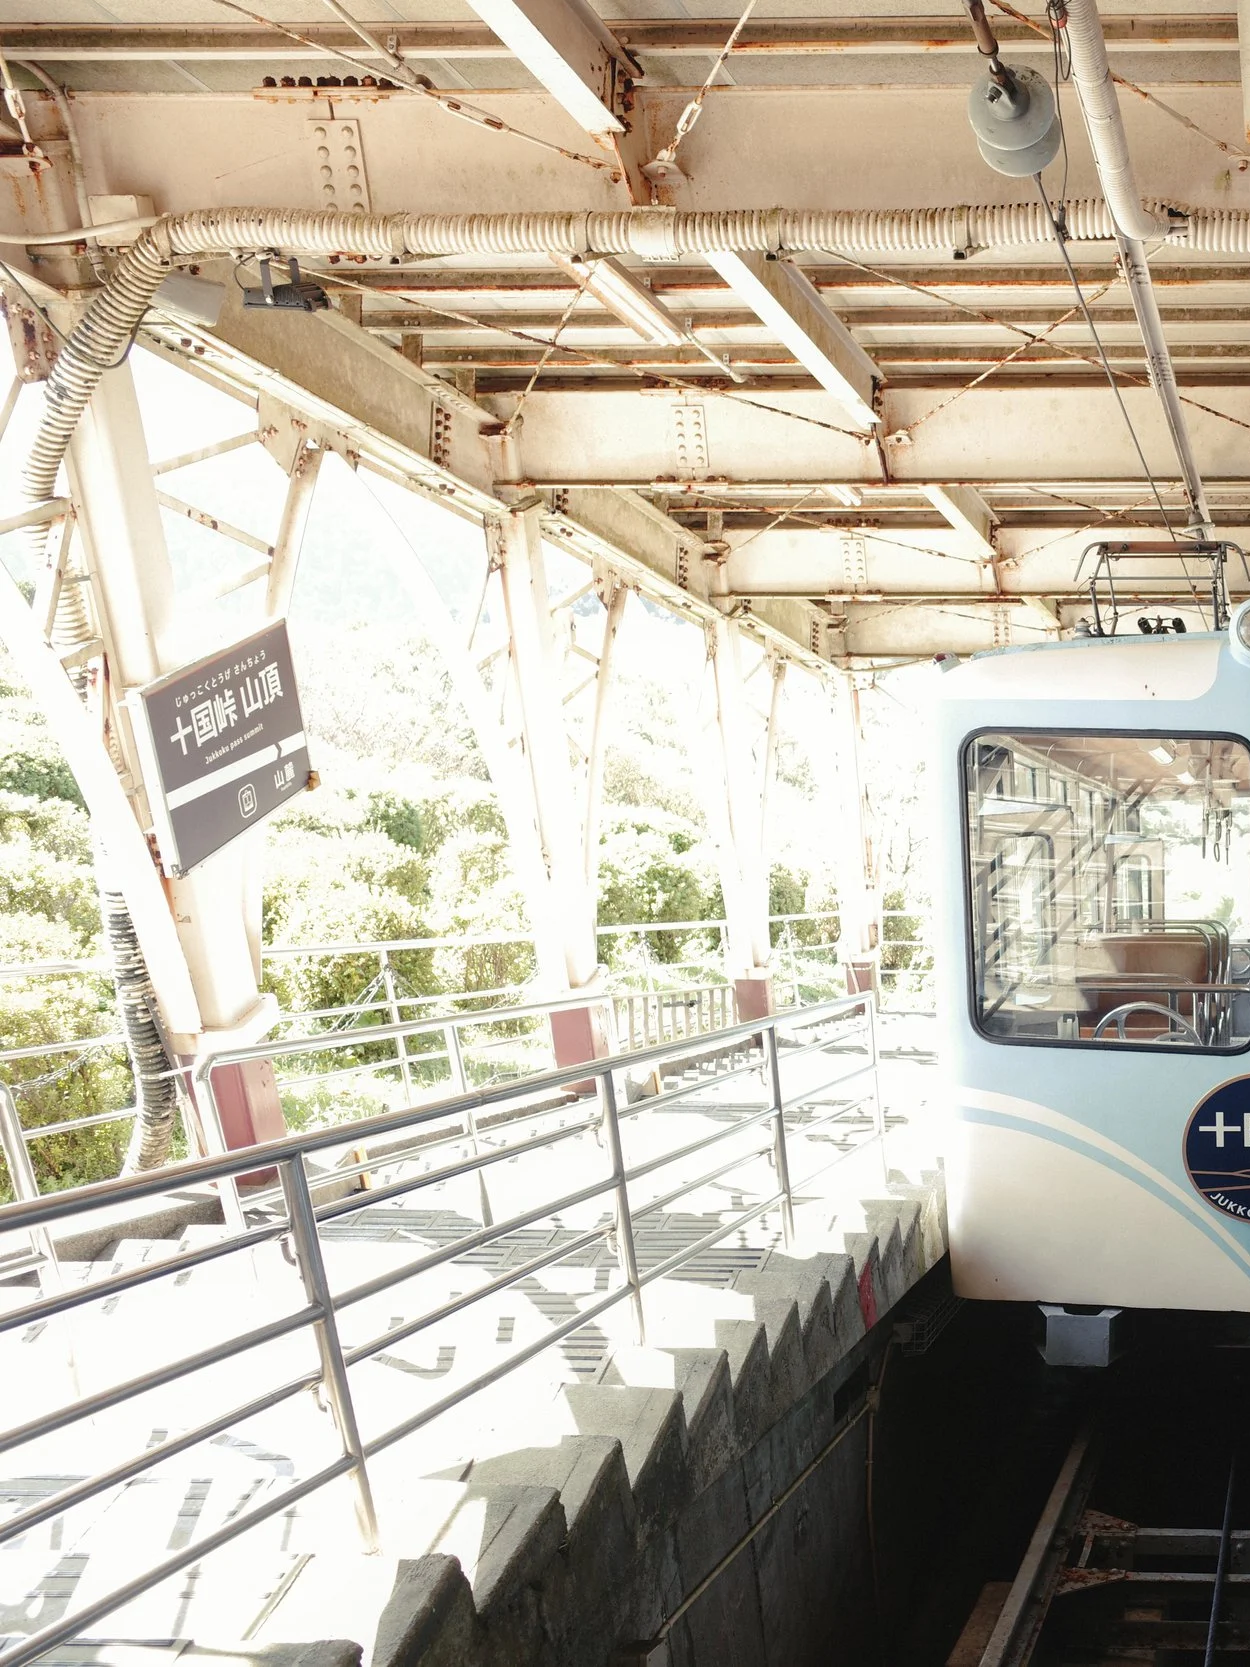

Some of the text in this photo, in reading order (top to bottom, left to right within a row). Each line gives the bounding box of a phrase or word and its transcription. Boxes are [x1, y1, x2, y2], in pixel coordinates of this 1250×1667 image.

[170, 661, 284, 755] 十国峠 山頂
[175, 650, 266, 708] じゅっこくとうげ さんちょう
[205, 723, 264, 764] Jukkoku pass summit
